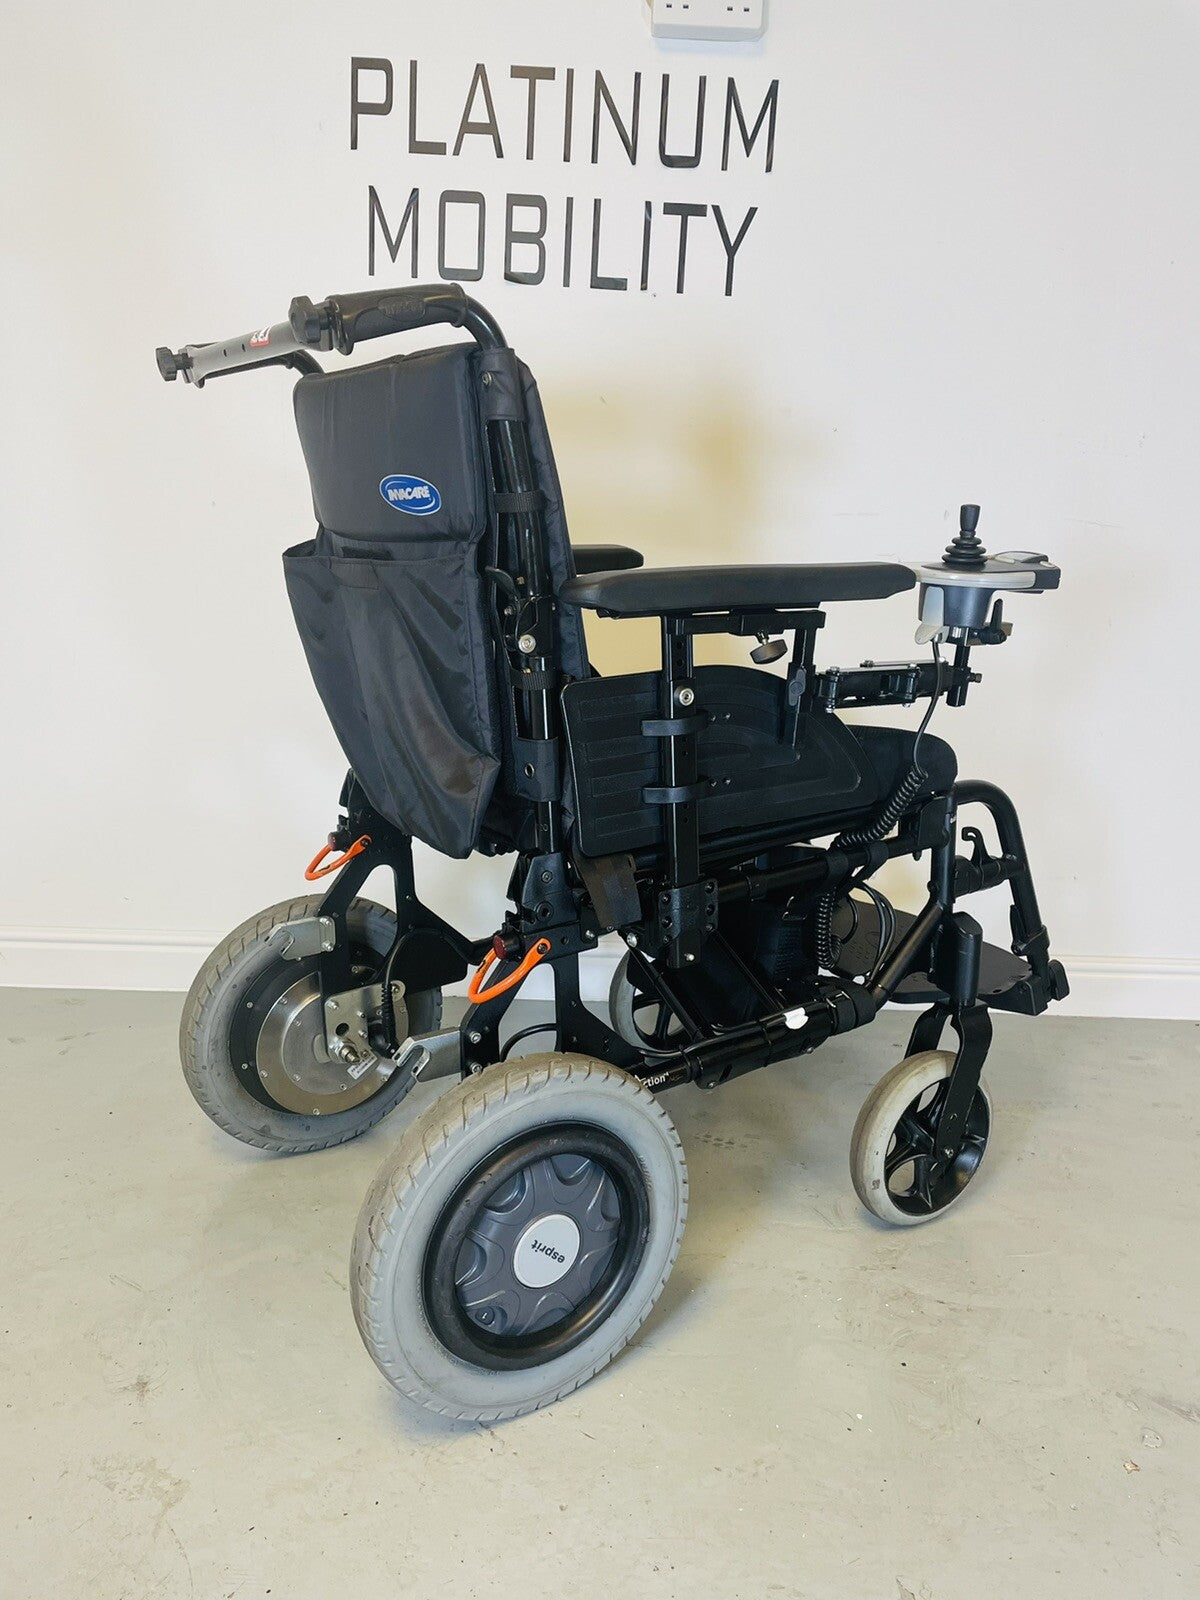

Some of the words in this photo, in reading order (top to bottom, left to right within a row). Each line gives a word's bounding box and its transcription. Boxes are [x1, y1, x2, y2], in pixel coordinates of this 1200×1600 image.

[350, 56, 780, 173] PLATINUM
[368, 185, 758, 297] MOBILITY
[387, 485, 431, 501] INVACARE
[531, 1239, 566, 1263] esprit
